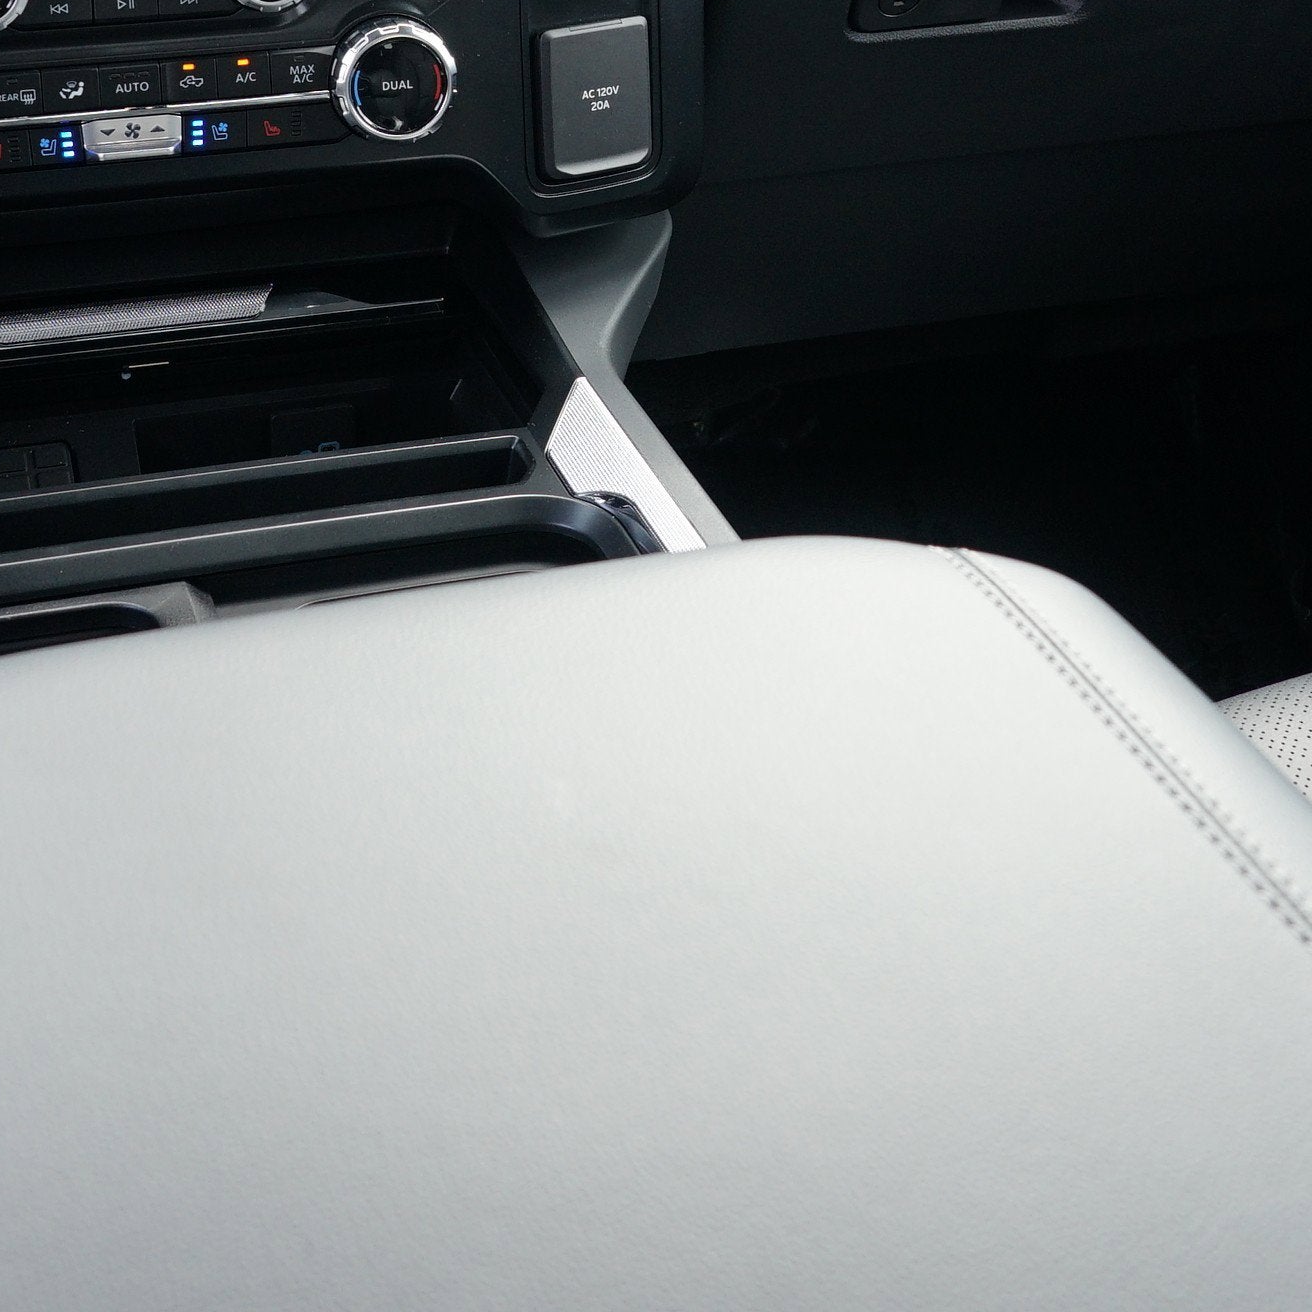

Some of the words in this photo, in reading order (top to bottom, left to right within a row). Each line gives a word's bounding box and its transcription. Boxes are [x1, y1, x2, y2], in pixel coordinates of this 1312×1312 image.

[289, 64, 315, 76] MAX
[235, 71, 257, 83] A/C
[292, 73, 314, 84] A/C
[115, 81, 149, 94] AUTO
[382, 79, 414, 91] DUAL
[582, 89, 595, 100] AC
[596, 85, 620, 98] 120V
[590, 99, 610, 112] 20A
